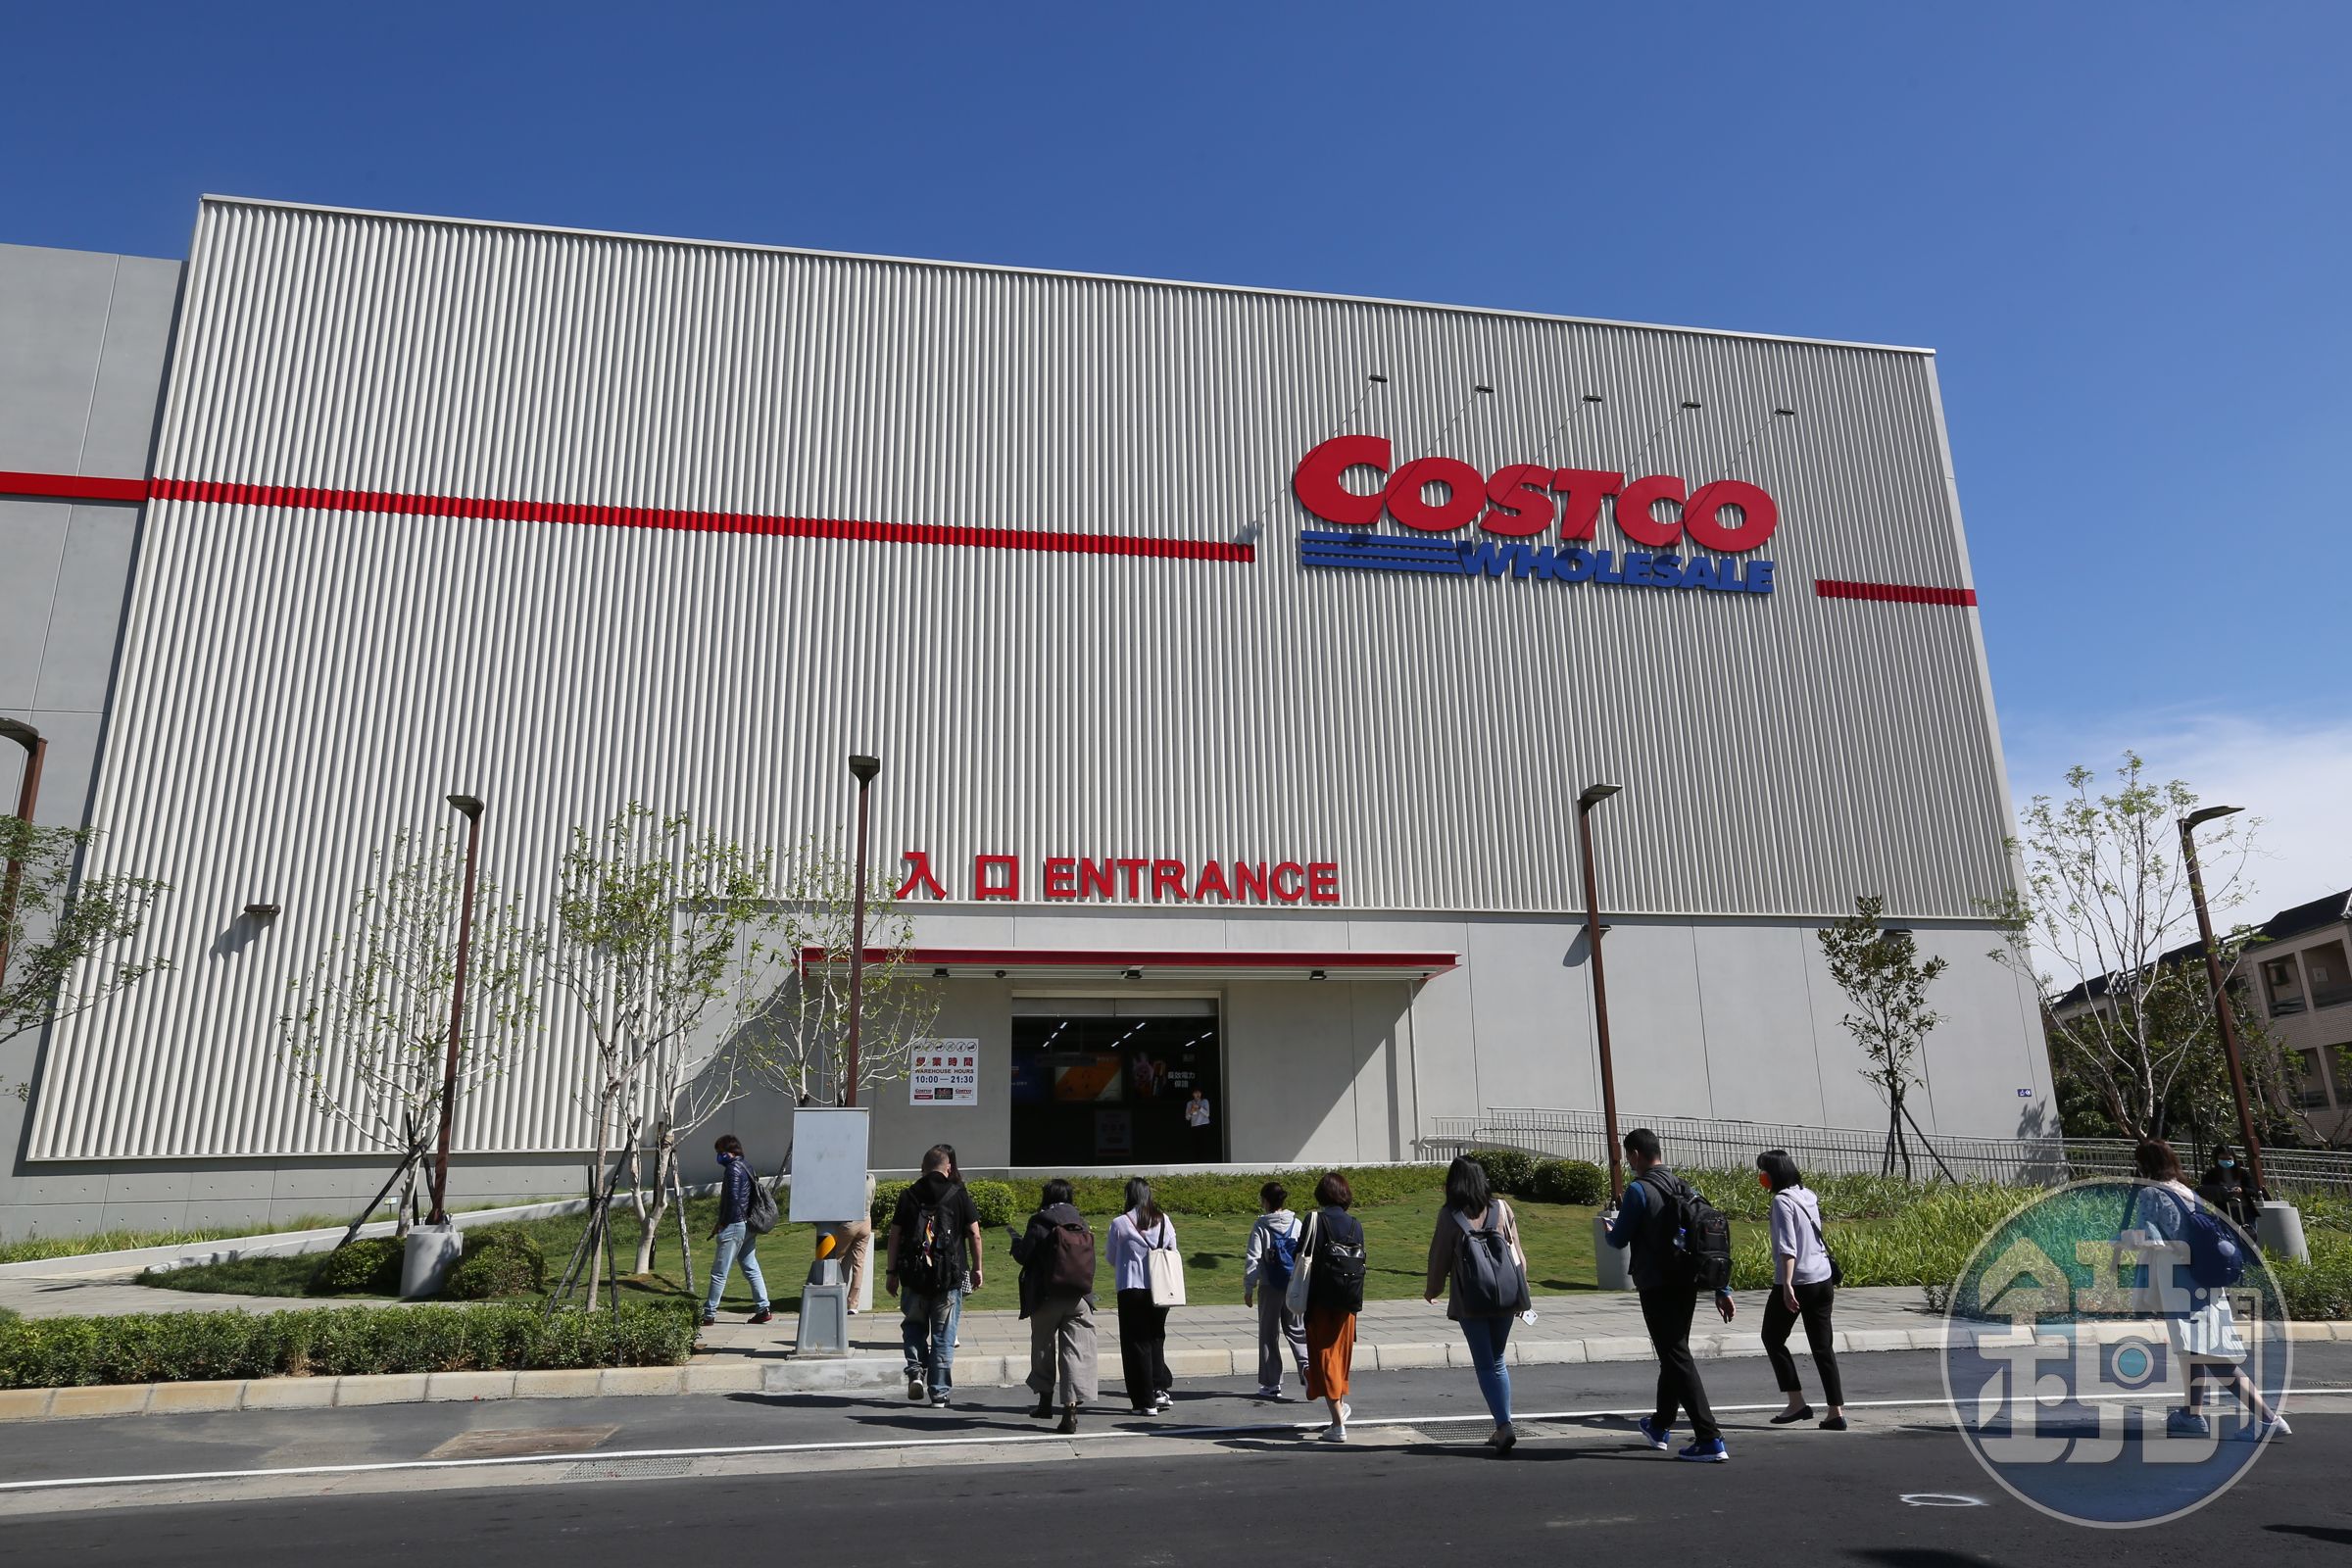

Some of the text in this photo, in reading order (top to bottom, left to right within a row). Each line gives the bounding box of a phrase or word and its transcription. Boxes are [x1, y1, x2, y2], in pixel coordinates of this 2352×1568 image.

[1294, 434, 1778, 553] COSTCO
[1456, 540, 1775, 594] WHOLESALE
[895, 851, 1340, 902] 入口 ENTRANCE
[915, 1057, 973, 1066] 營業時間
